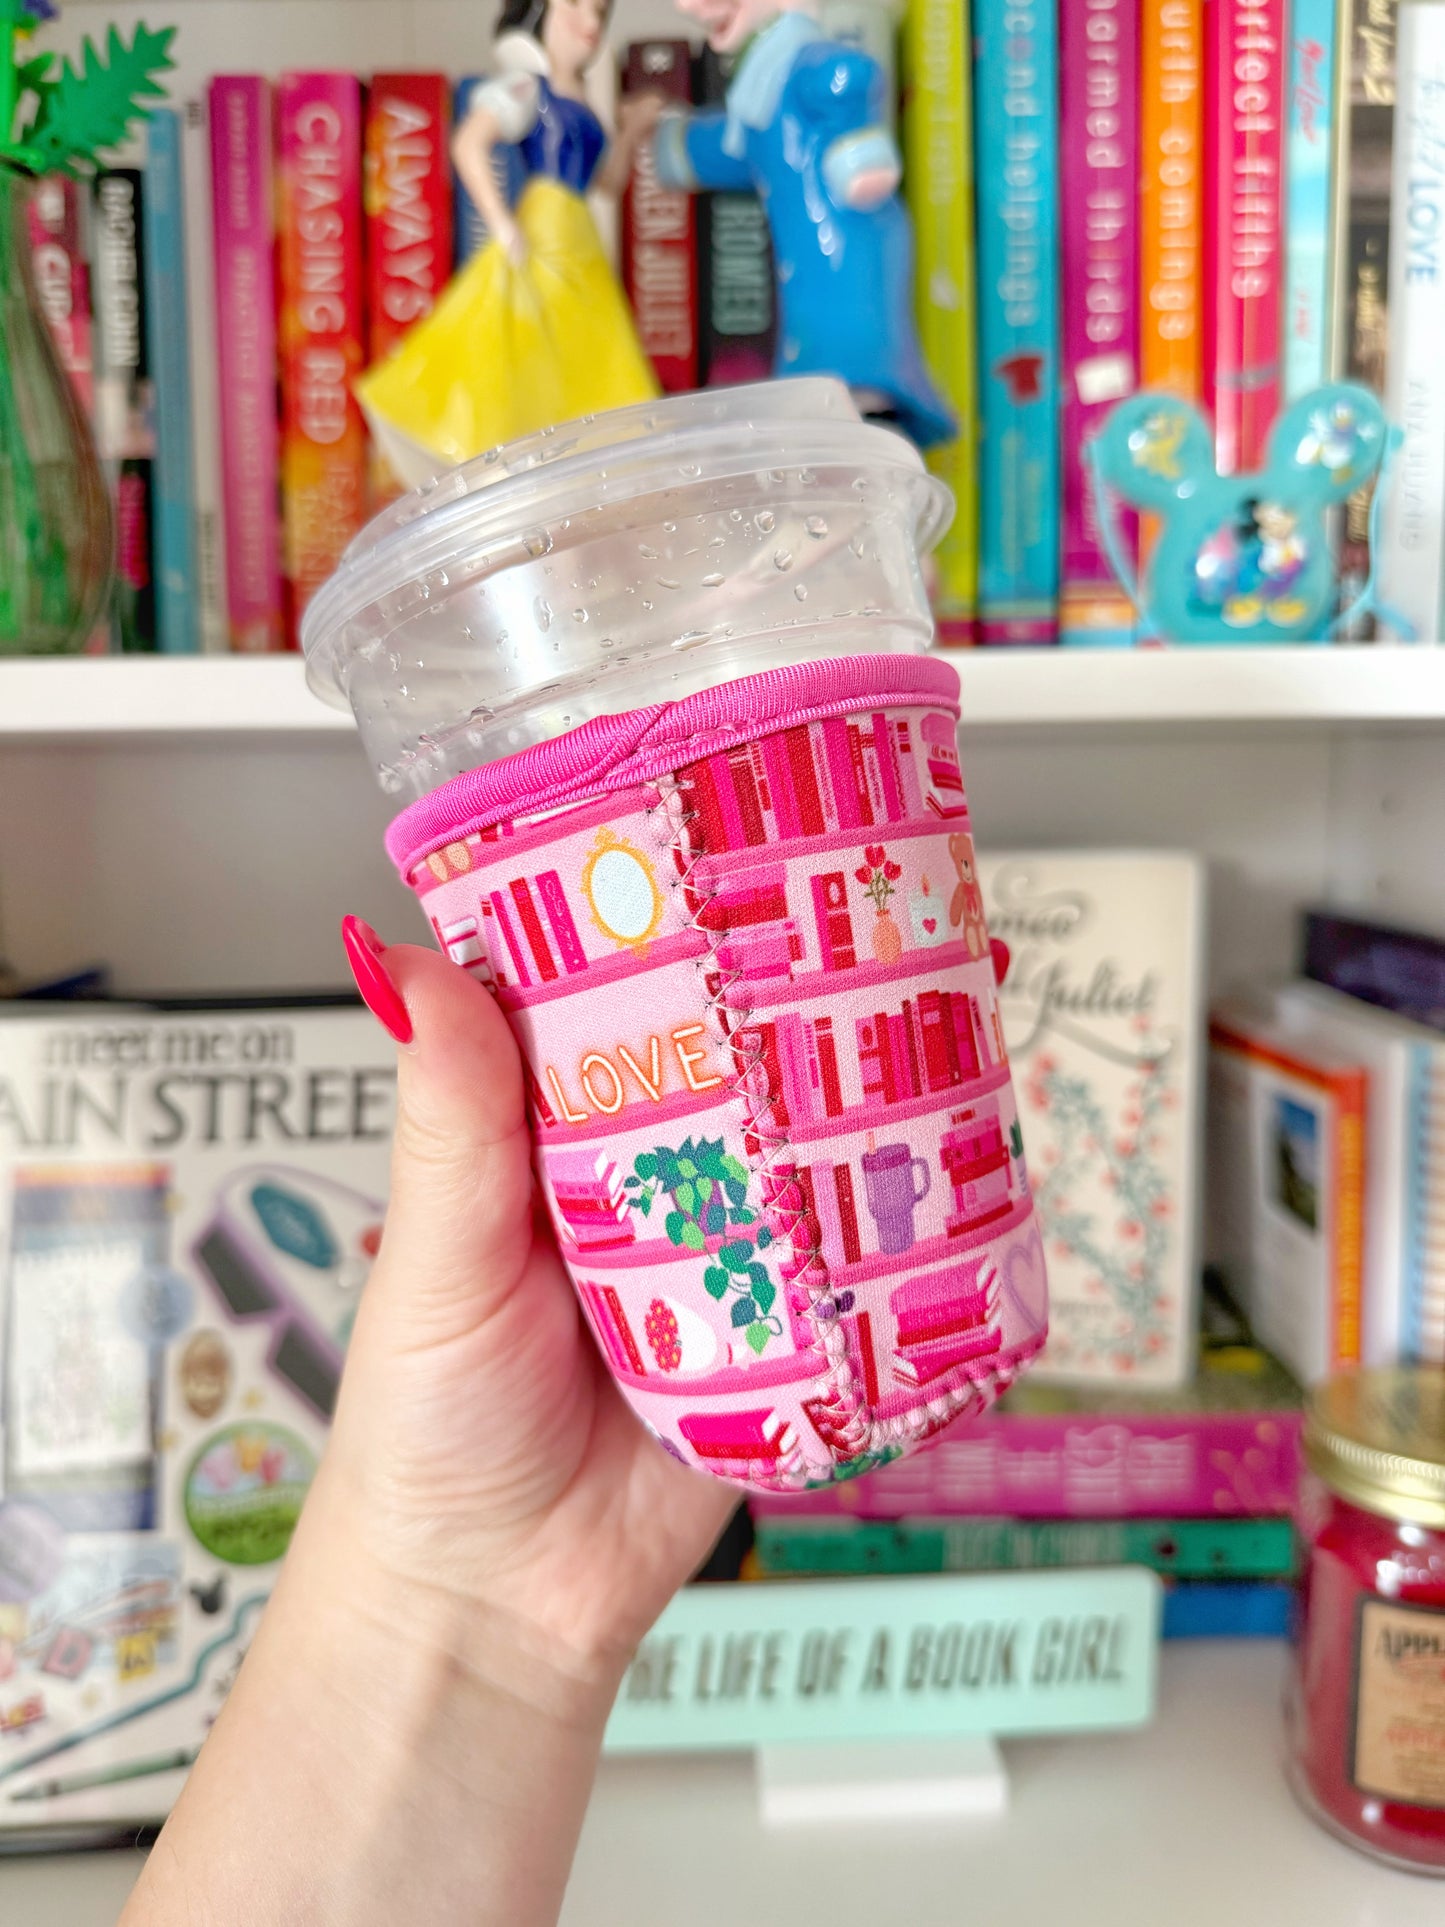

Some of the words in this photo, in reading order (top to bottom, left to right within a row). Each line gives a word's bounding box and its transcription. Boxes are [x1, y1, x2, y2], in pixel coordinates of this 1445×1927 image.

[1003, 0, 1043, 117] cond
[1085, 0, 1128, 168] armed
[1159, 0, 1198, 103] urth
[1233, 0, 1278, 134] rfect
[100, 177, 137, 281] RACHEL
[299, 101, 345, 335] CHASING
[382, 98, 433, 323] ALWAYS
[711, 198, 771, 336] ROMEO
[997, 131, 1042, 327] helpings
[1149, 126, 1195, 341] comings
[1230, 156, 1277, 299] fifths
[1405, 177, 1442, 286] LOVE
[104, 283, 140, 367] COHN
[636, 243, 692, 357] JULIET
[302, 351, 347, 444] RED
[44, 1025, 151, 1064] meet
[165, 1028, 228, 1064] me
[241, 1023, 295, 1063] on
[545, 1022, 726, 1124] LOVE
[0, 1073, 129, 1146] AIN
[151, 1067, 398, 1147] STREE
[628, 1632, 685, 1710] HE
[693, 1628, 787, 1707] LIFE
[796, 1625, 853, 1697] OF
[860, 1624, 890, 1693] A
[905, 1619, 1024, 1693] BOOK
[1030, 1613, 1129, 1687] GIRL
